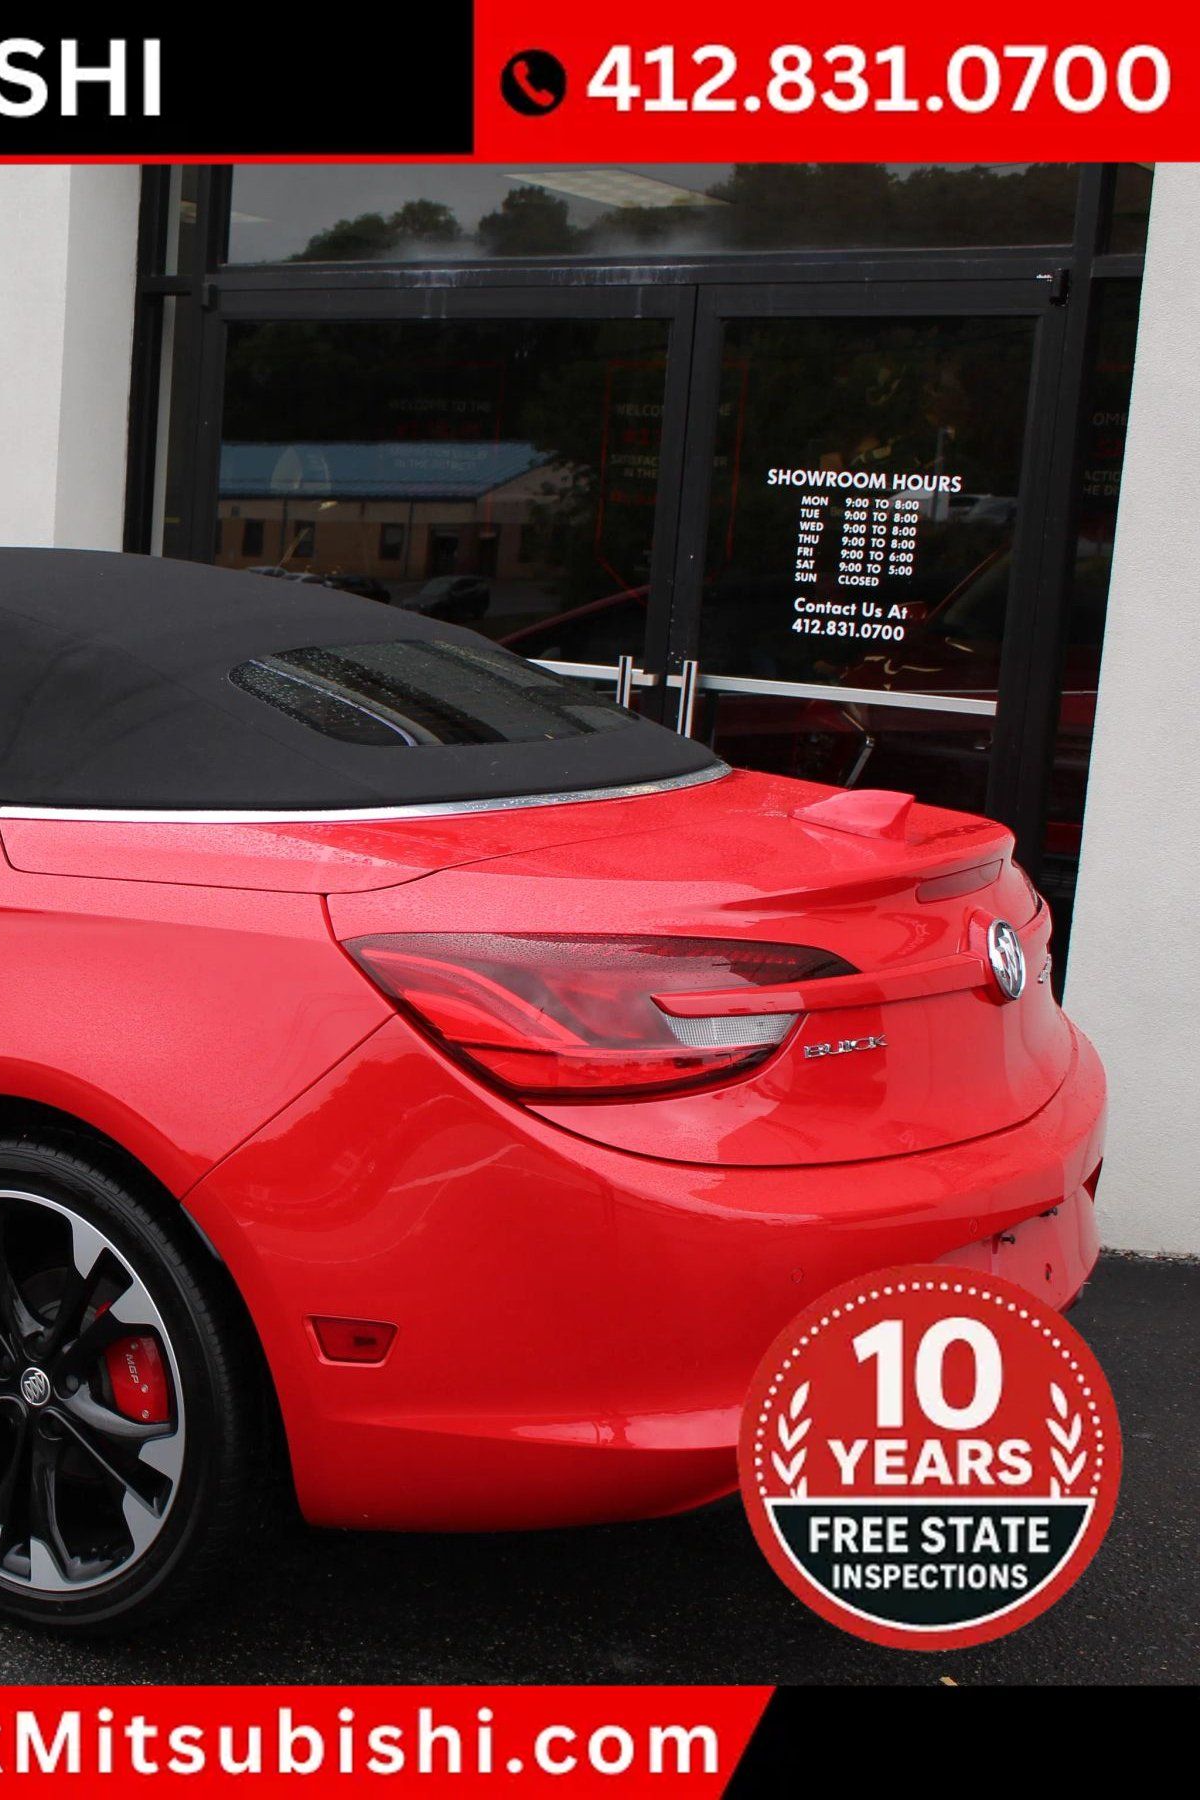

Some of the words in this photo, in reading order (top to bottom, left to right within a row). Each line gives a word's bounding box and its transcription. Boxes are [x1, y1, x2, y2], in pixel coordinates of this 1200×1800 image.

[767, 468, 887, 489] SHOWROOM
[892, 473, 962, 493] HOURS
[801, 496, 829, 506] MON
[845, 497, 869, 508] 9:00
[874, 499, 889, 509] TO
[894, 500, 919, 511] 8:00
[800, 508, 820, 519] TUE
[844, 510, 867, 521] 9:00
[872, 512, 887, 522] TO
[893, 513, 918, 524] 8:00
[799, 521, 824, 532] WED
[842, 523, 866, 534] 9:00
[871, 525, 887, 535] TO
[892, 526, 917, 537] 8:00
[798, 534, 819, 545] THU
[841, 536, 865, 547] 9:00
[870, 538, 886, 548] TO
[890, 539, 915, 550] 8:00
[797, 546, 813, 557] FRI
[840, 549, 864, 560] 9:00
[868, 551, 884, 561] TO
[889, 552, 914, 563] 6:00
[795, 559, 815, 570] SAT
[838, 562, 862, 573] 9:00
[866, 563, 881, 574] TO
[888, 565, 913, 576] 5:00
[795, 572, 817, 583] SUN
[838, 575, 879, 586] CLOSED
[794, 597, 856, 616] Contact
[862, 602, 882, 618] Us
[887, 605, 908, 620] At
[792, 618, 905, 641] 412.831.0700
[803, 1034, 888, 1059] BUICK
